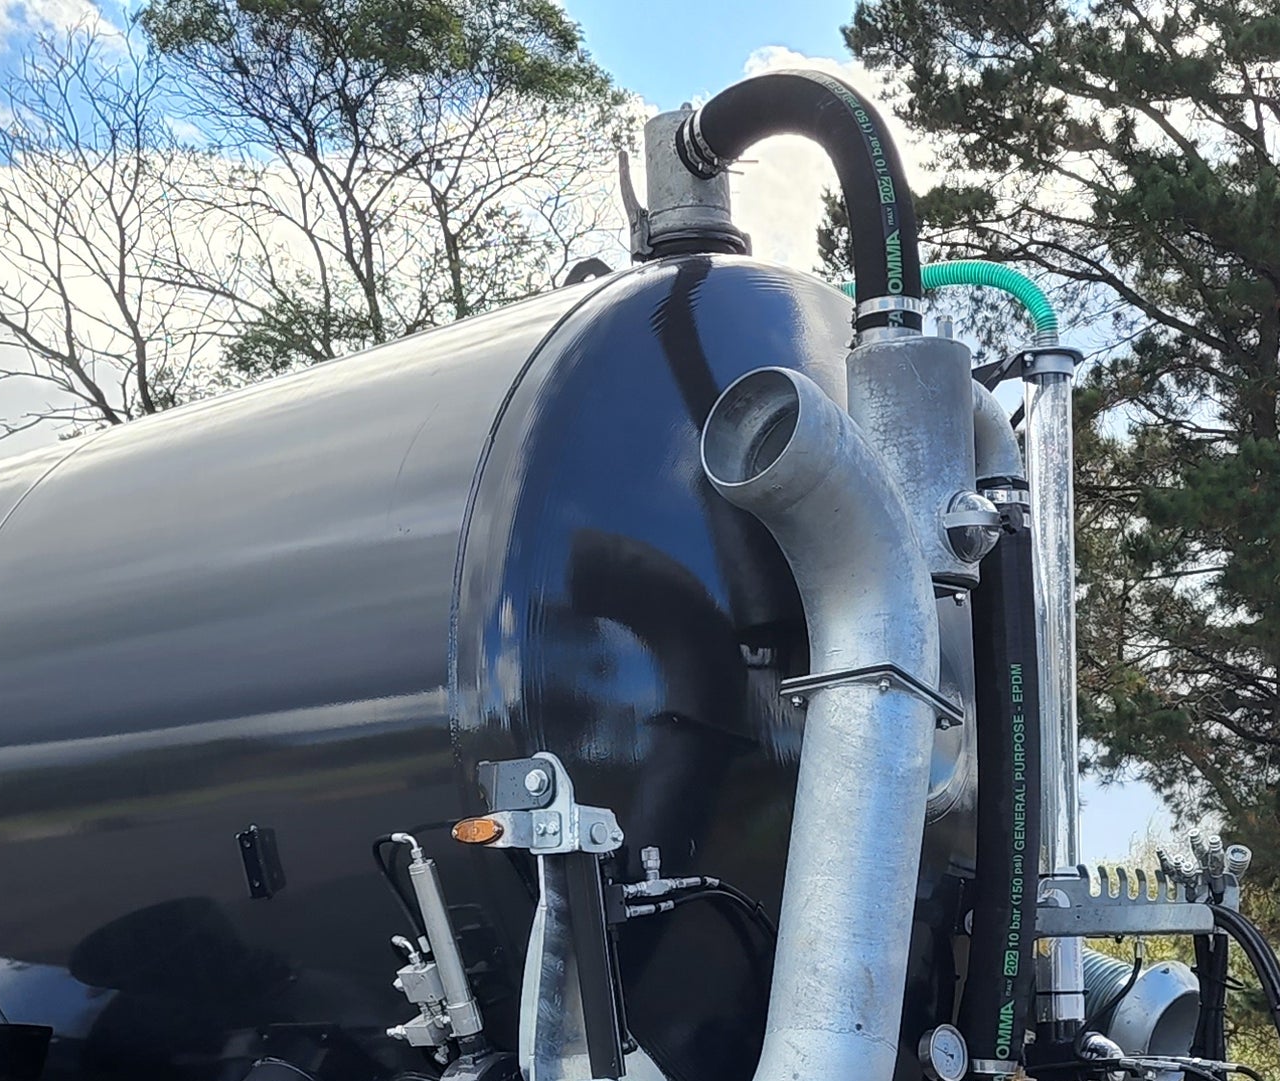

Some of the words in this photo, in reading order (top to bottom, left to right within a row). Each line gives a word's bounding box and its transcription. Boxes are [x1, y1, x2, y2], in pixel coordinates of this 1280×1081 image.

[854, 108, 874, 134] (150
[868, 135, 883, 156] bar
[874, 159, 887, 174] 10
[881, 176, 895, 203] 202
[887, 206, 895, 226] ITALY
[1010, 663, 1024, 703] EPDM
[1013, 713, 1026, 782] PURPOSE
[1013, 788, 1026, 852] GENERAL
[1012, 854, 1025, 875] psi)
[1011, 877, 1024, 905] (150
[1009, 907, 1022, 930] bar
[1008, 932, 1020, 948] 10
[1004, 950, 1019, 976] 202
